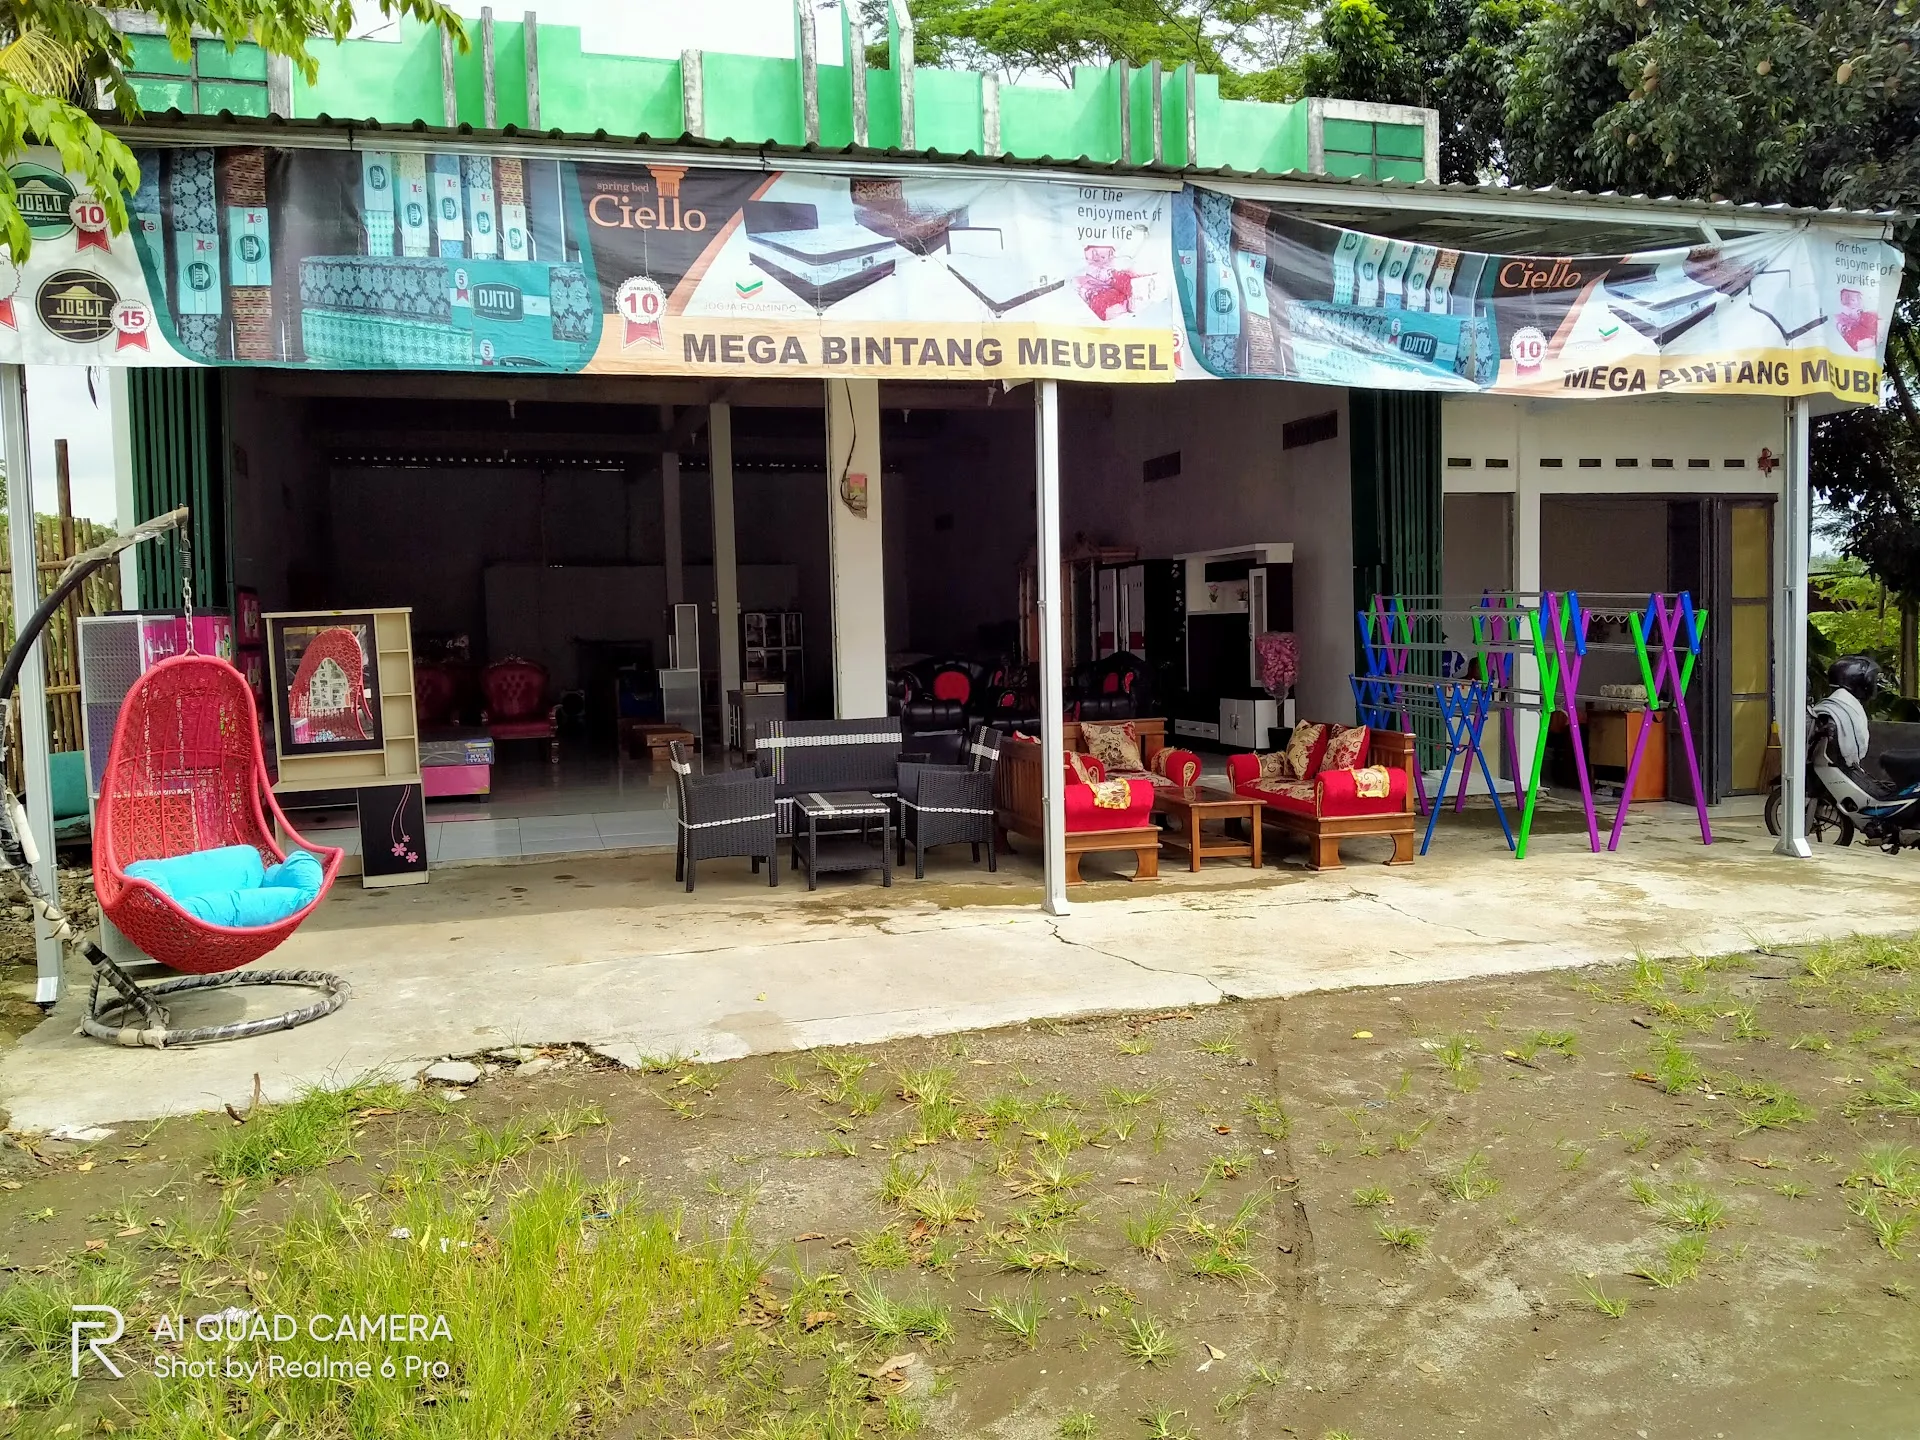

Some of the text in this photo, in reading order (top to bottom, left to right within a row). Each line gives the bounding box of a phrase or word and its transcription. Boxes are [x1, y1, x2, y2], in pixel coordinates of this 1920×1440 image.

[596, 181, 649, 194] spring bed
[1078, 187, 1123, 202] for the
[16, 194, 62, 213] JOGLO
[75, 205, 105, 225] 10
[588, 193, 707, 233] Ciello
[1077, 204, 1163, 222] enjoyment of
[1077, 225, 1133, 241] your life
[1851, 241, 1868, 255] the
[1499, 261, 1582, 289] Ciello
[1880, 264, 1895, 277] of
[458, 275, 465, 286] 5
[1836, 272, 1876, 288] your life
[56, 299, 104, 316] JOGLO
[478, 288, 515, 310] DJITU
[624, 292, 660, 315] 10
[119, 310, 145, 327] 15
[683, 333, 1169, 371] MEGA BINTANG MEUBEL
[1403, 335, 1433, 354] DJITU
[1515, 340, 1542, 359] 10
[1563, 365, 1647, 392] MEGA
[1657, 360, 1789, 390] BINTANG
